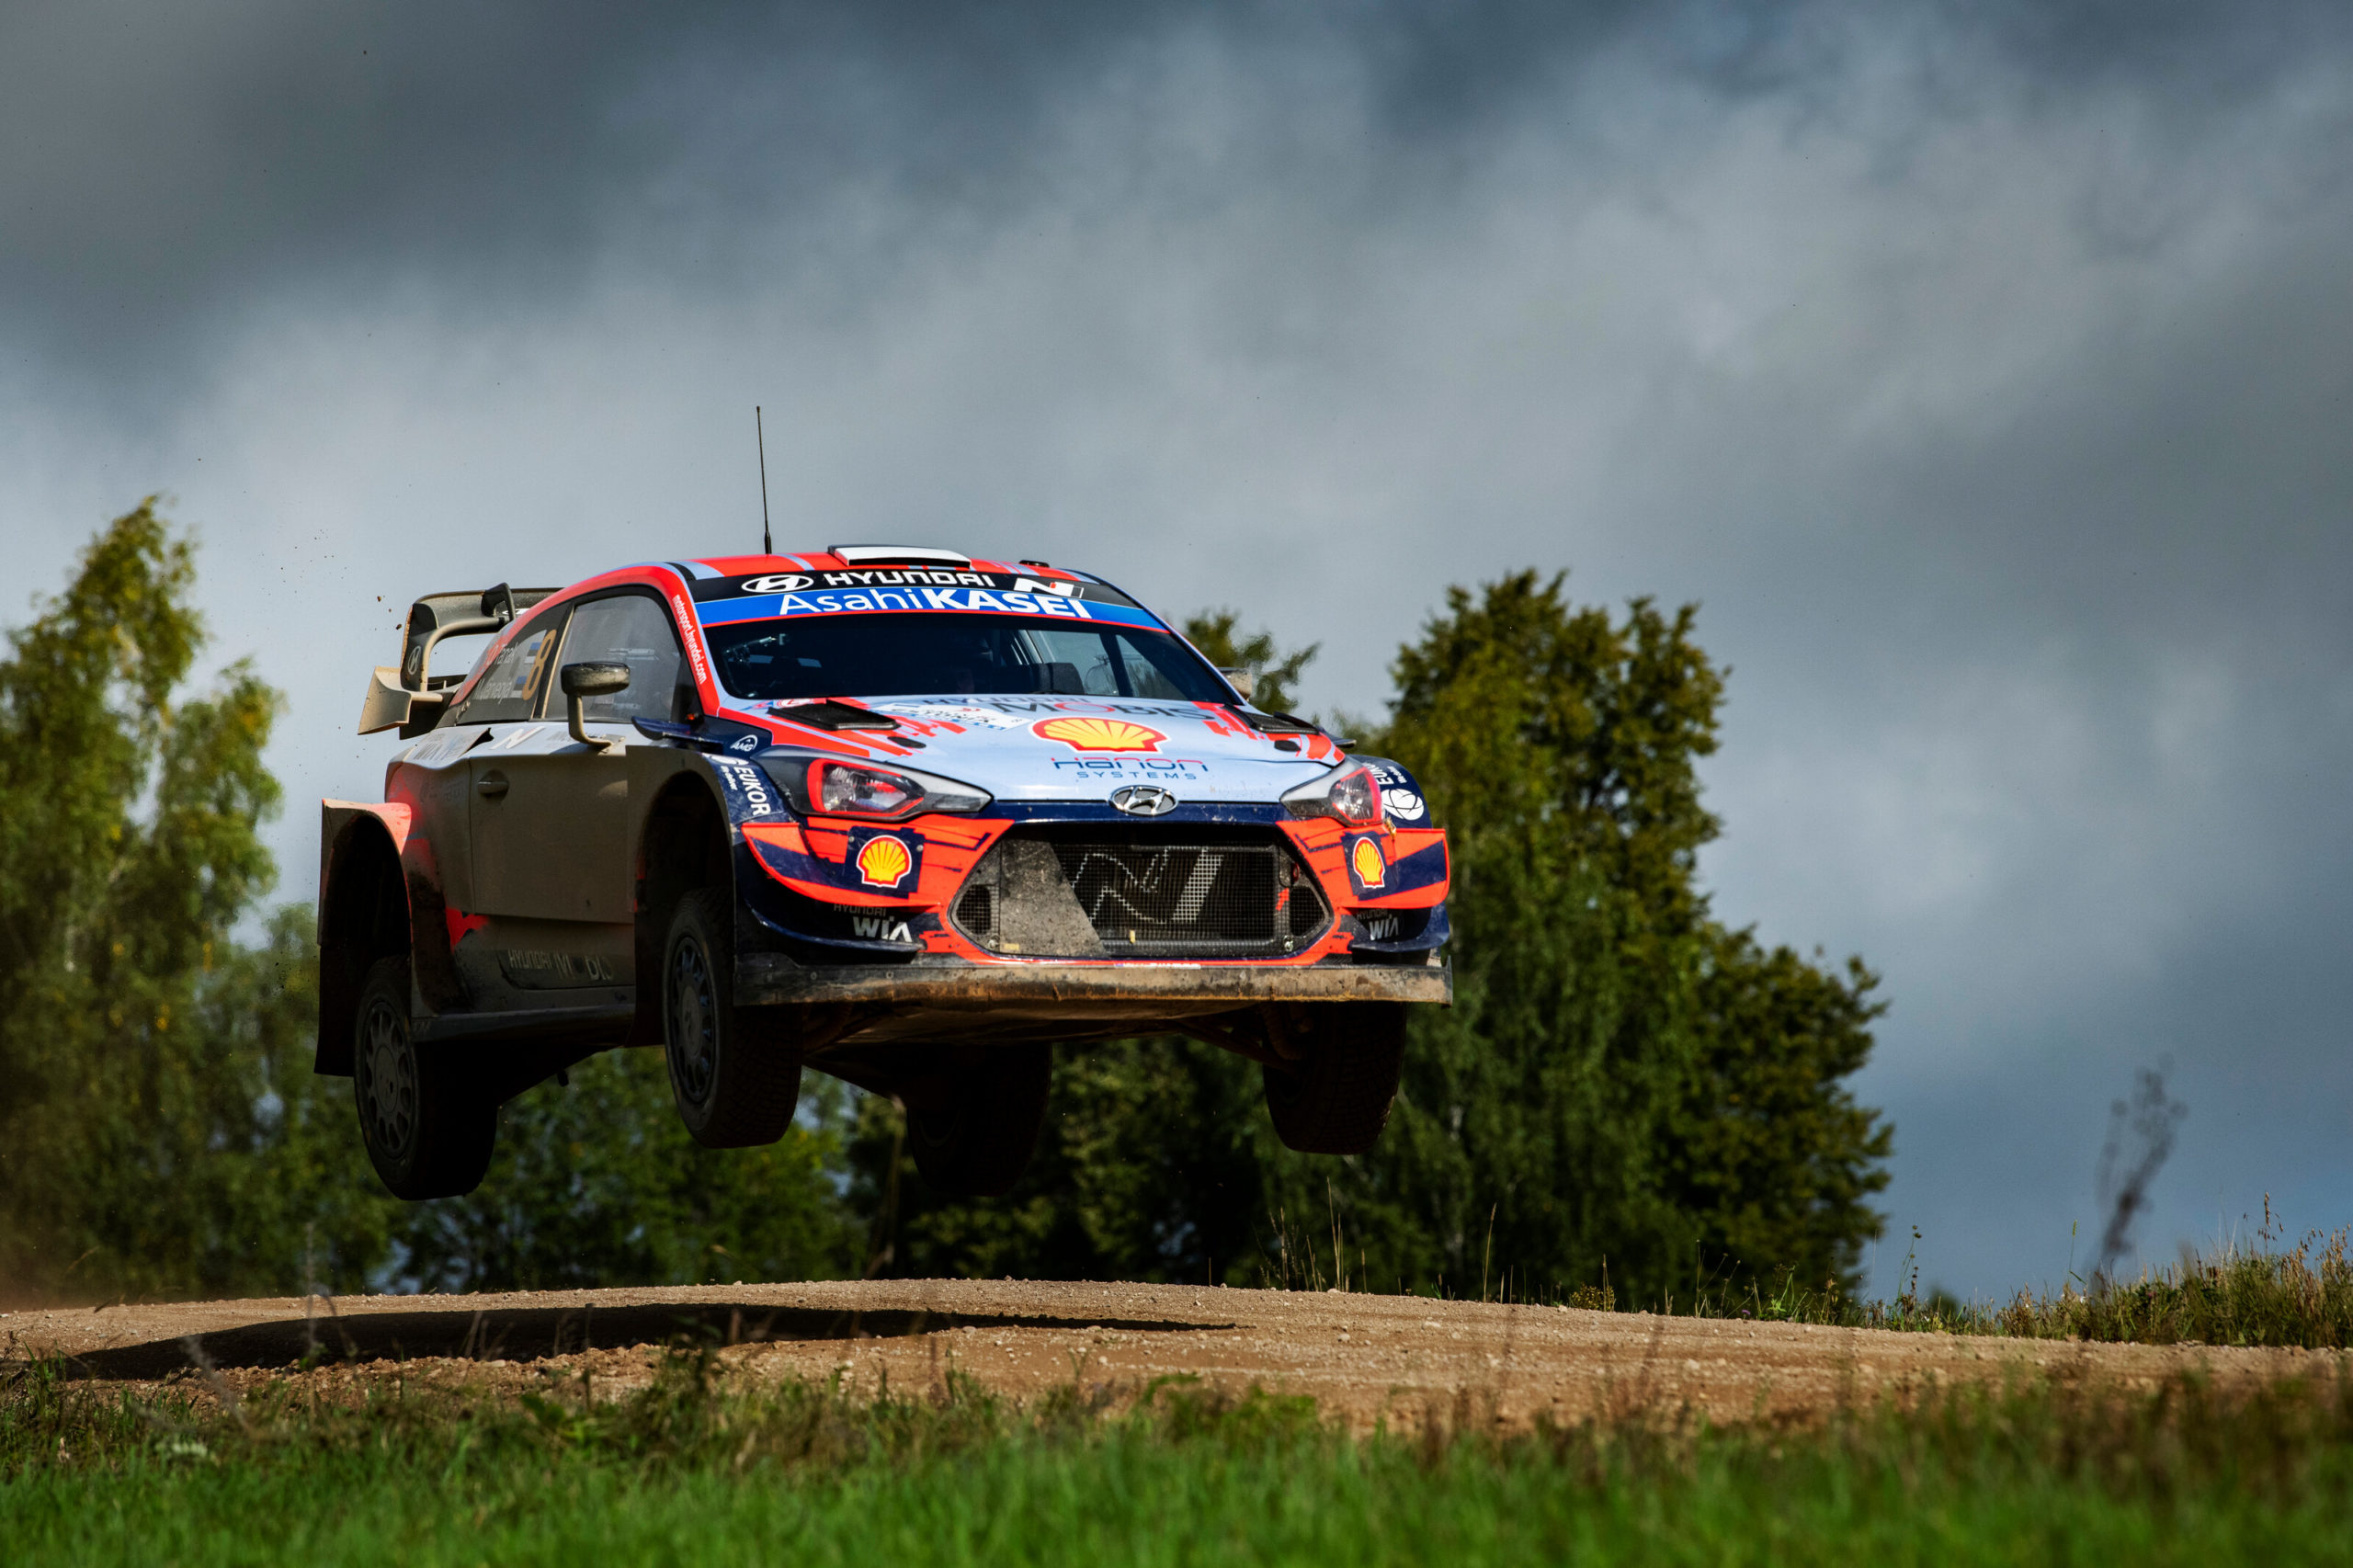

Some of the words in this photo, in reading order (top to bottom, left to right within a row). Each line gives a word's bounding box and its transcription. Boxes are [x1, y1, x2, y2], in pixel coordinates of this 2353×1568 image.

[824, 571, 995, 587] HYUNDAI
[672, 594, 707, 685] motorsport.hyundai.com
[521, 629, 557, 700] 8
[988, 702, 1215, 720] MOBIS
[1077, 771, 1197, 780] SYSTEMS
[733, 766, 772, 816] EUKOR
[834, 903, 887, 917] HYUNDAI
